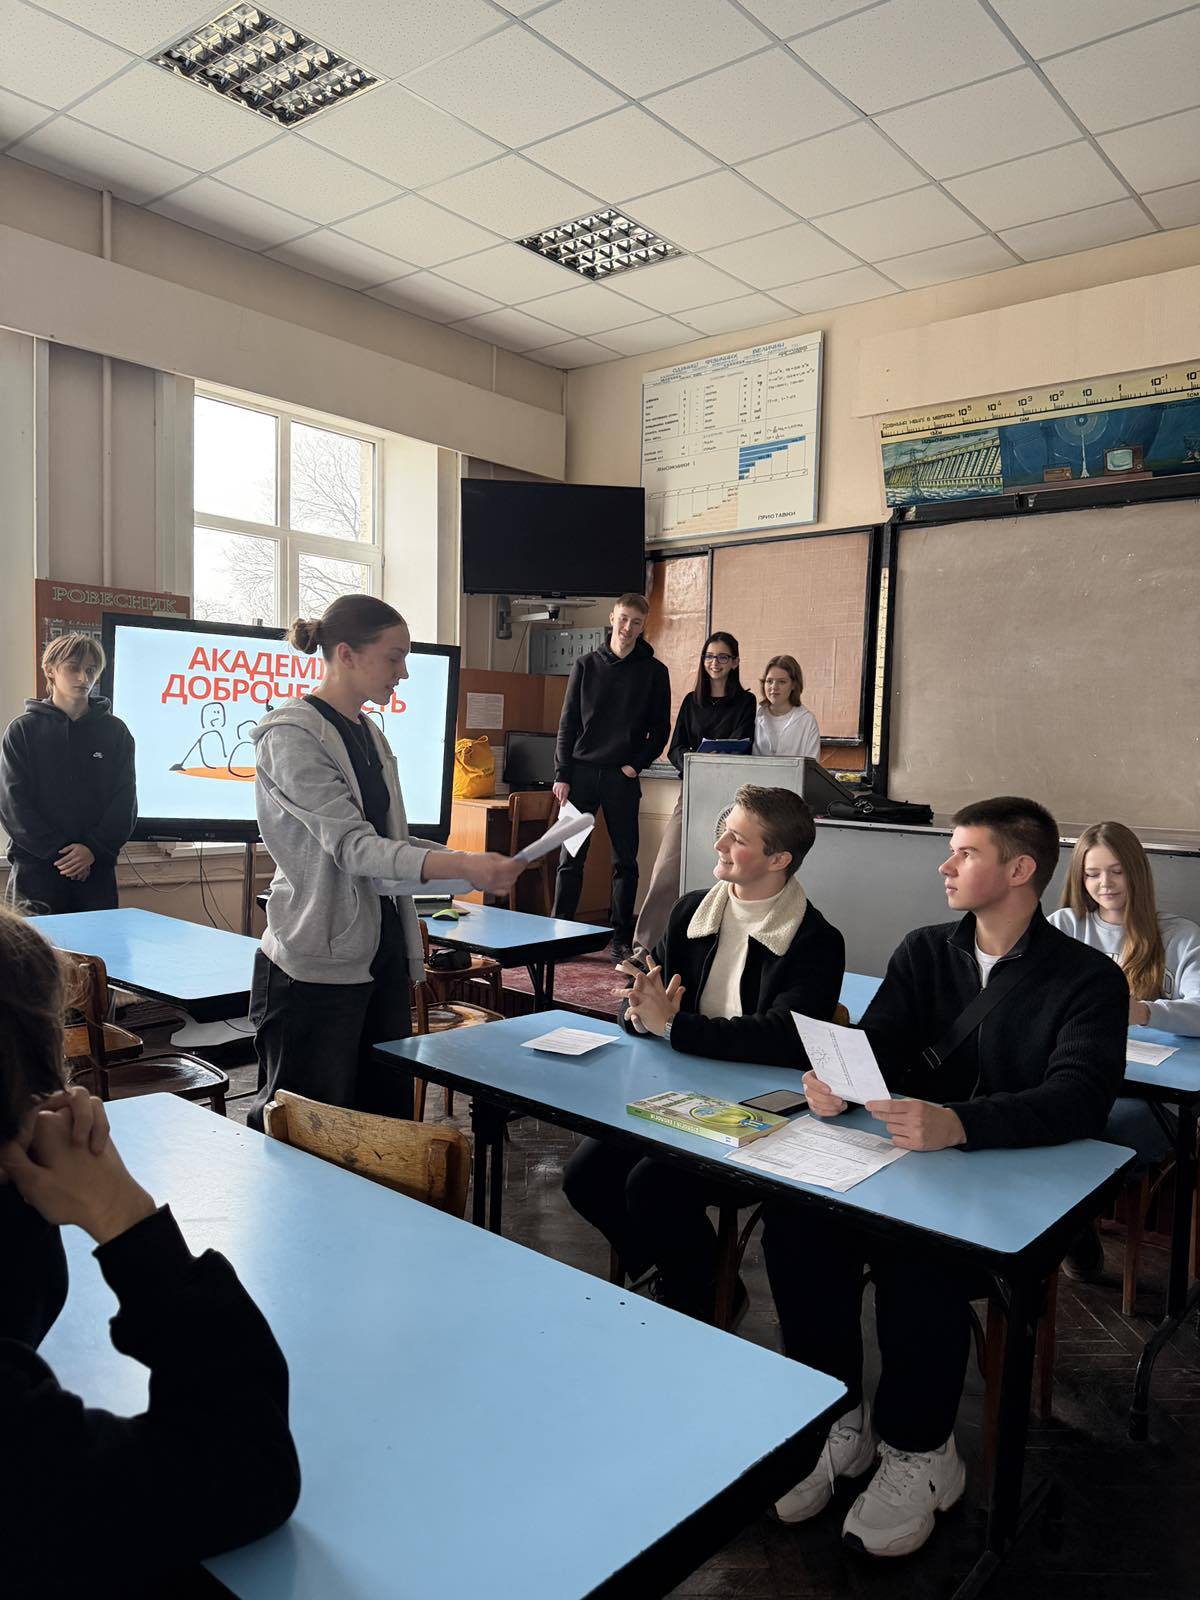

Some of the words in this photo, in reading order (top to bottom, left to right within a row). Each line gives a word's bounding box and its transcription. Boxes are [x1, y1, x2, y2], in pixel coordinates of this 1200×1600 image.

[1082, 388, 1092, 397] 10
[52, 586, 177, 613] РОВЕСНИК
[188, 646, 325, 683] АКАДЕМІ
